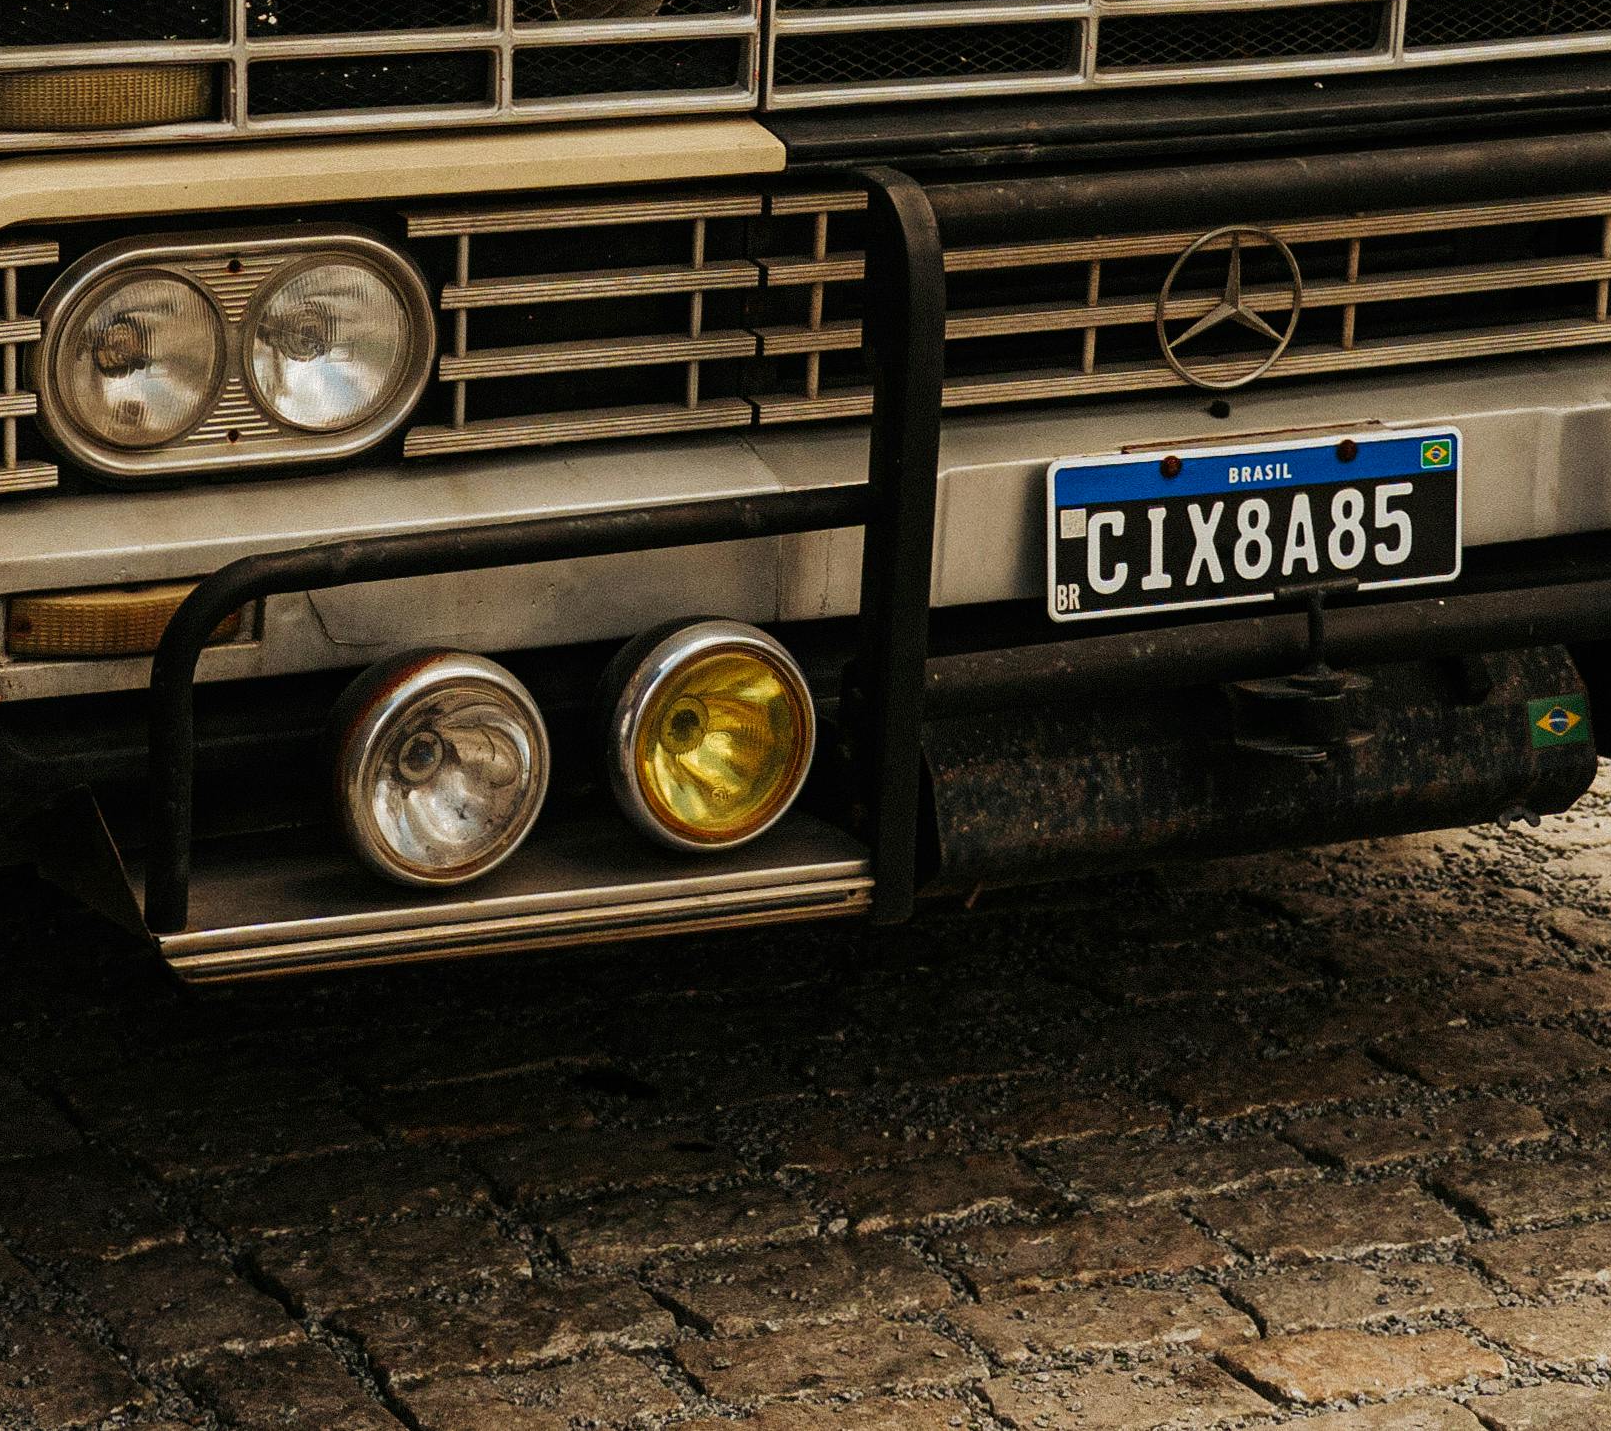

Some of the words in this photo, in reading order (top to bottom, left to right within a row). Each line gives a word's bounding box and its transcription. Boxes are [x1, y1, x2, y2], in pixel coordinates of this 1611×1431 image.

[1229, 462, 1292, 484] BRASIL
[1087, 482, 1413, 595] CIX8A85
[1057, 583, 1080, 611] BR
